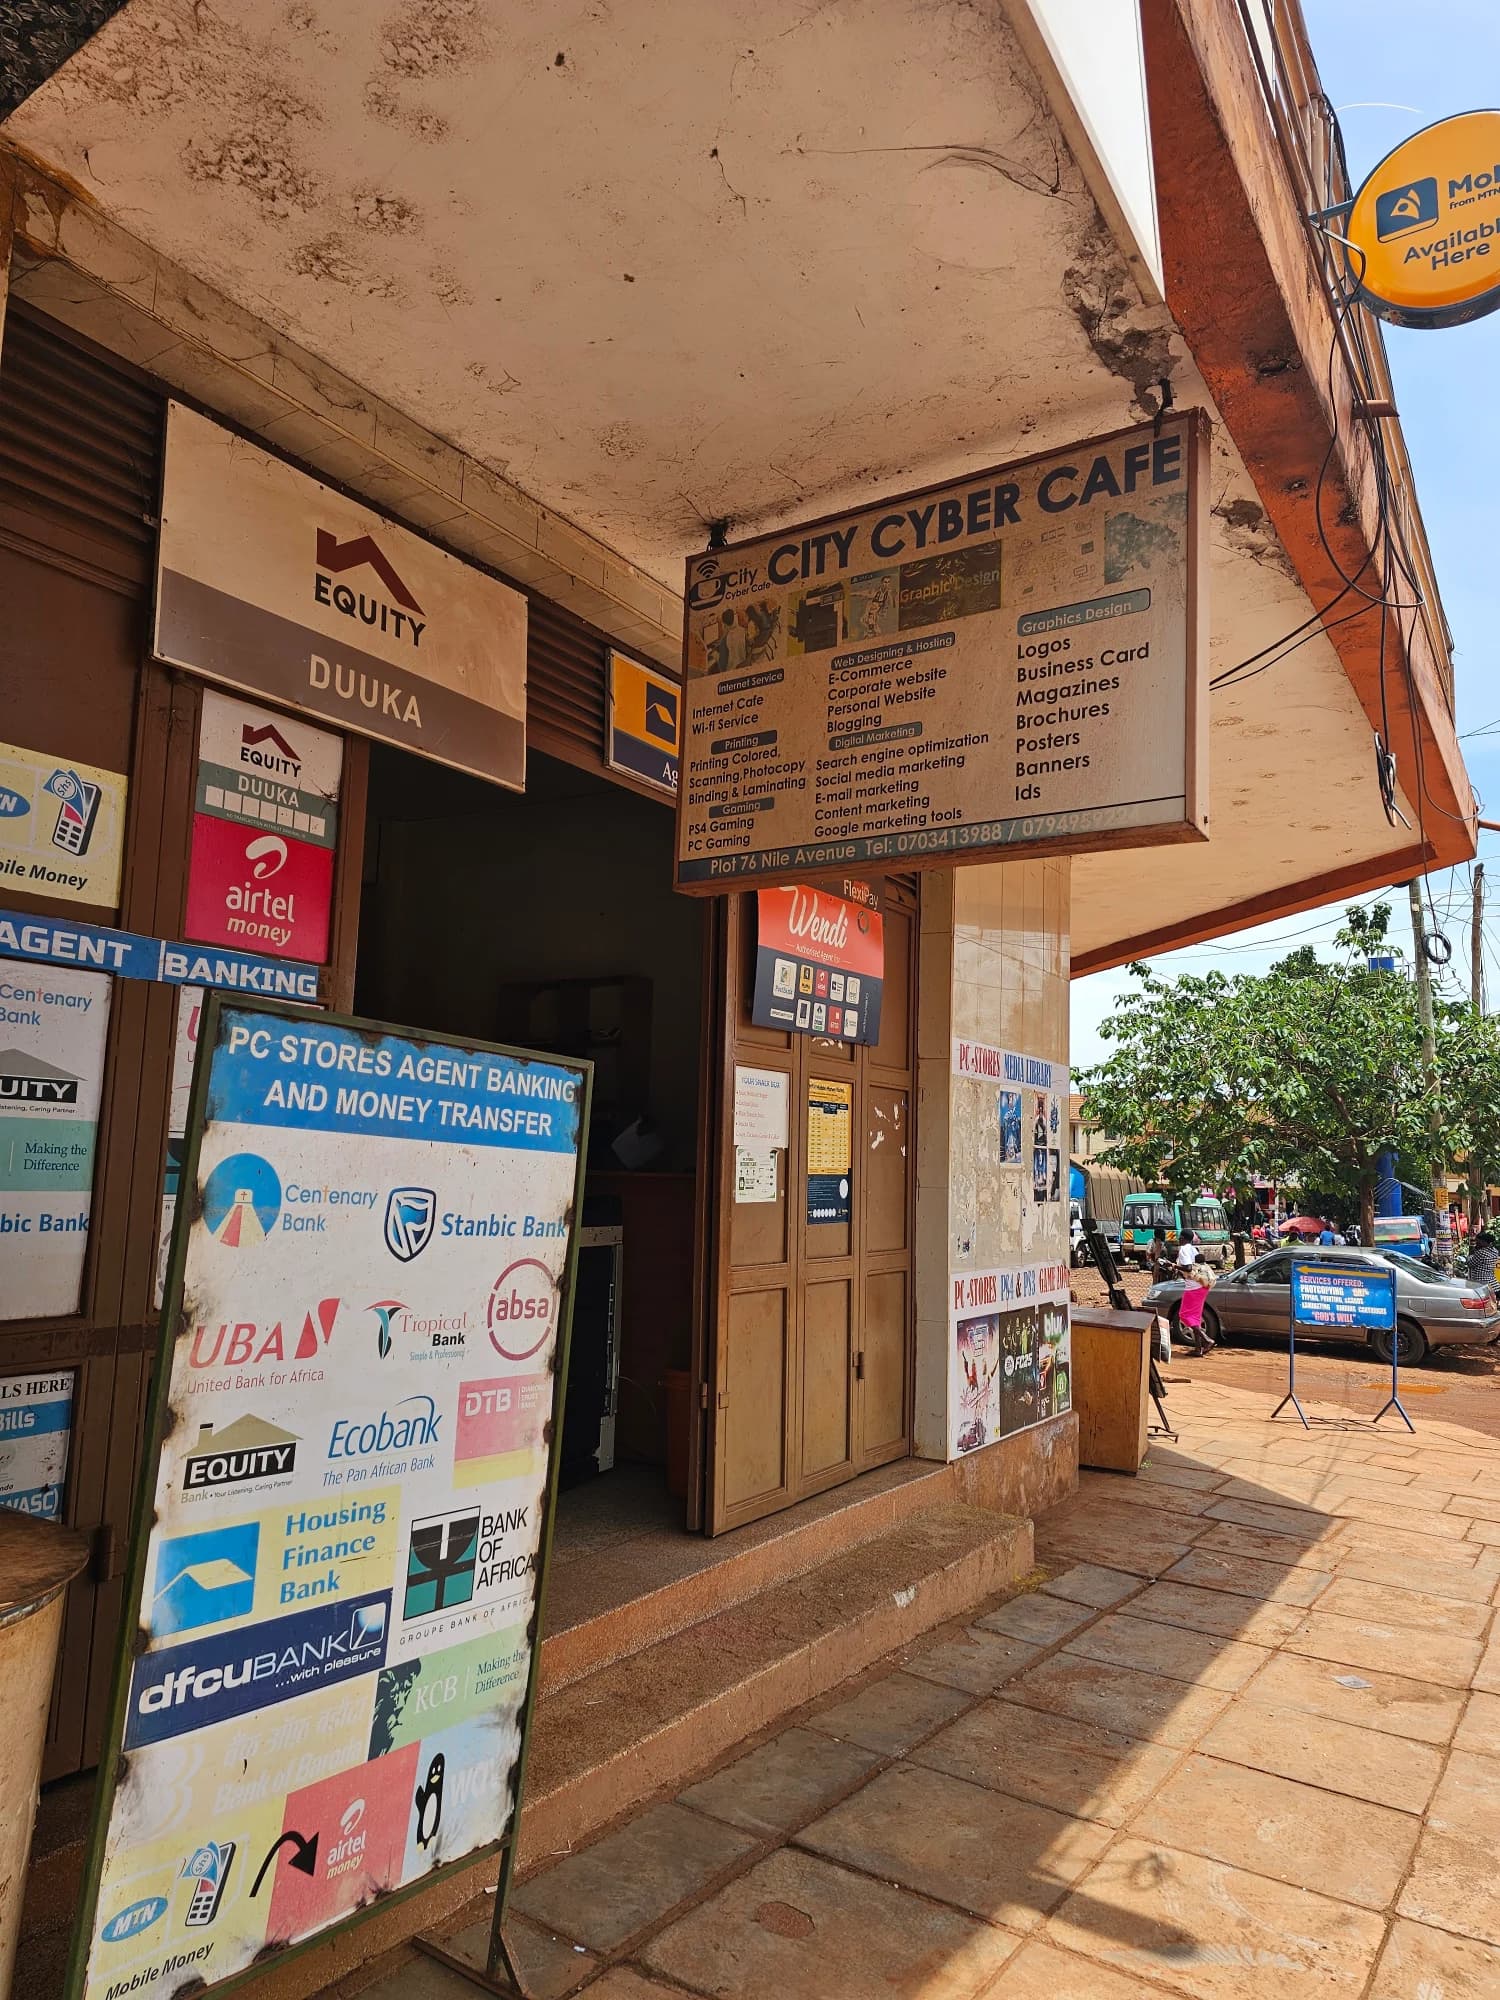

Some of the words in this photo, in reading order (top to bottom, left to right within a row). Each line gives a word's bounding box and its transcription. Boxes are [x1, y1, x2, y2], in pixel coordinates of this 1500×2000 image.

[1449, 196, 1475, 209] from
[1403, 217, 1500, 264] Availabl
[1431, 243, 1490, 271] Here
[767, 525, 859, 586] CITY
[870, 484, 1021, 558] CYBER
[1037, 435, 1182, 513] CAFE
[725, 586, 749, 600] Cyber
[751, 581, 771, 593] Cafe
[727, 568, 757, 588] City
[315, 573, 427, 648] EQUITY
[1022, 611, 1081, 634] Graphics
[1085, 601, 1132, 621] Design
[834, 657, 855, 669] Web
[857, 646, 904, 665] Designing
[906, 645, 913, 653] &
[916, 635, 953, 652] Hosting
[1017, 637, 1071, 660] Logos
[1017, 657, 1094, 683] Business
[1100, 642, 1149, 666] Card
[718, 678, 750, 694] Internet
[751, 672, 783, 686] Service
[828, 658, 913, 685] E-Commerce
[828, 679, 892, 701] Corporate
[896, 666, 947, 687] website
[310, 654, 423, 729] DUUKA
[827, 697, 880, 717] Personal
[884, 687, 936, 706] Website
[1016, 675, 1120, 706] Magazines
[692, 702, 734, 719] Internet
[736, 695, 764, 710] Cafe
[1016, 702, 1110, 730] Brochures
[692, 721, 715, 735] Wi-fi
[718, 713, 759, 730] Service
[827, 714, 882, 733] Blogging
[725, 736, 759, 750] Printing
[816, 752, 857, 771] Search
[861, 745, 904, 764] engine
[908, 732, 989, 757] optimization
[835, 735, 864, 749] Digital
[866, 727, 915, 744] Marketing
[1016, 732, 1081, 753] Posters
[240, 746, 302, 779] EQUITY
[690, 755, 729, 772] Printing
[732, 746, 781, 765] Colored,
[815, 770, 852, 788] Social
[855, 763, 895, 781] media
[899, 754, 965, 775] marketing
[1016, 754, 1090, 778] Banners
[57, 779, 72, 796] Shs
[238, 774, 300, 809] DUUKA
[689, 788, 729, 805] Binding
[732, 786, 739, 797] &
[742, 777, 806, 797] Laminating
[815, 786, 852, 804] E-mail
[855, 779, 919, 800] marketing
[1015, 784, 1041, 801] Ids
[723, 801, 761, 815] Gaming
[814, 803, 862, 821] Content
[865, 795, 930, 816] marketing
[689, 823, 707, 836] PS4
[709, 817, 755, 833] Gaming
[814, 818, 859, 838] Google
[862, 811, 927, 833] marketing
[931, 807, 962, 822] tools
[688, 840, 703, 852] PC
[706, 834, 750, 850] Gaming
[711, 858, 736, 875] Plot
[740, 855, 757, 871] 76
[761, 852, 790, 868] Nile
[794, 846, 856, 865] Avenue
[865, 838, 892, 856] Tel:
[898, 821, 1003, 851] 0703413988
[1008, 821, 1017, 841] /
[29, 865, 88, 891] Money
[225, 882, 296, 924] airtel
[844, 879, 879, 911] FlexiPay
[779, 885, 849, 949] Wendi
[227, 916, 292, 948] money
[164, 952, 318, 999] BANKING
[0, 983, 93, 1012] Centenary
[228, 1026, 271, 1059] PC
[279, 1034, 392, 1077] STORES
[397, 1054, 482, 1090] AGENT
[487, 1068, 576, 1103] BANKING
[959, 1043, 970, 1070] PC
[1004, 1053, 1024, 1083] MEDIA
[1026, 1059, 1052, 1088] LIBRARY
[29, 1105, 51, 1114] Caring
[264, 1079, 328, 1112] AND
[335, 1089, 432, 1124] MONEY
[438, 1100, 553, 1137] TRANSFER
[25, 1143, 68, 1158] Making
[70, 1143, 88, 1156] the
[24, 1158, 80, 1172] Difference
[285, 1183, 378, 1210] Centenary
[39, 1212, 89, 1232] Bank
[282, 1213, 326, 1232] Bank
[441, 1212, 517, 1238] Stanbic
[522, 1215, 567, 1238] Bank
[954, 1279, 964, 1310] PC
[1001, 1273, 1014, 1301] PS4
[1015, 1272, 1022, 1298] &
[1024, 1270, 1035, 1297] PS3
[1039, 1266, 1055, 1293] GAME
[1299, 1276, 1332, 1285] SERVICES
[1333, 1278, 1364, 1288] OFFERED:
[494, 1288, 549, 1321] absa
[398, 1312, 468, 1337] Tropical
[188, 1321, 284, 1369] UBA
[432, 1332, 465, 1346] Bank
[1015, 1352, 1033, 1371] FC25
[26, 1378, 71, 1396] HERE
[187, 1375, 233, 1395] United
[235, 1372, 265, 1391] Bank
[269, 1371, 287, 1387] for
[289, 1367, 325, 1384] Africa
[465, 1388, 512, 1417] DTB
[327, 1411, 443, 1459] Ecobank
[188, 1446, 292, 1485] EQUITY
[322, 1471, 343, 1487] The
[346, 1467, 367, 1483] Pan
[370, 1461, 407, 1480] African
[409, 1454, 435, 1474] Bank
[285, 1502, 387, 1537] Housing
[480, 1506, 529, 1538] BANK
[282, 1532, 376, 1570] Finance
[479, 1538, 503, 1564] OF
[279, 1568, 342, 1605] Bank
[476, 1555, 536, 1591] AFRICA
[399, 1625, 445, 1646] GROUPE
[450, 1614, 478, 1631] BANK
[483, 1608, 496, 1618] OF
[139, 1634, 348, 1715] dfcuBANK
[324, 1647, 382, 1674] pleasure
[476, 1656, 510, 1677] Making
[414, 1675, 458, 1715] KCB
[475, 1671, 520, 1695] Difference
[327, 1829, 367, 1864] airtel
[326, 1853, 364, 1881] money
[111, 1902, 158, 1938] MTN
[104, 1966, 160, 2000] Mobile
[162, 1942, 214, 1977] Money
